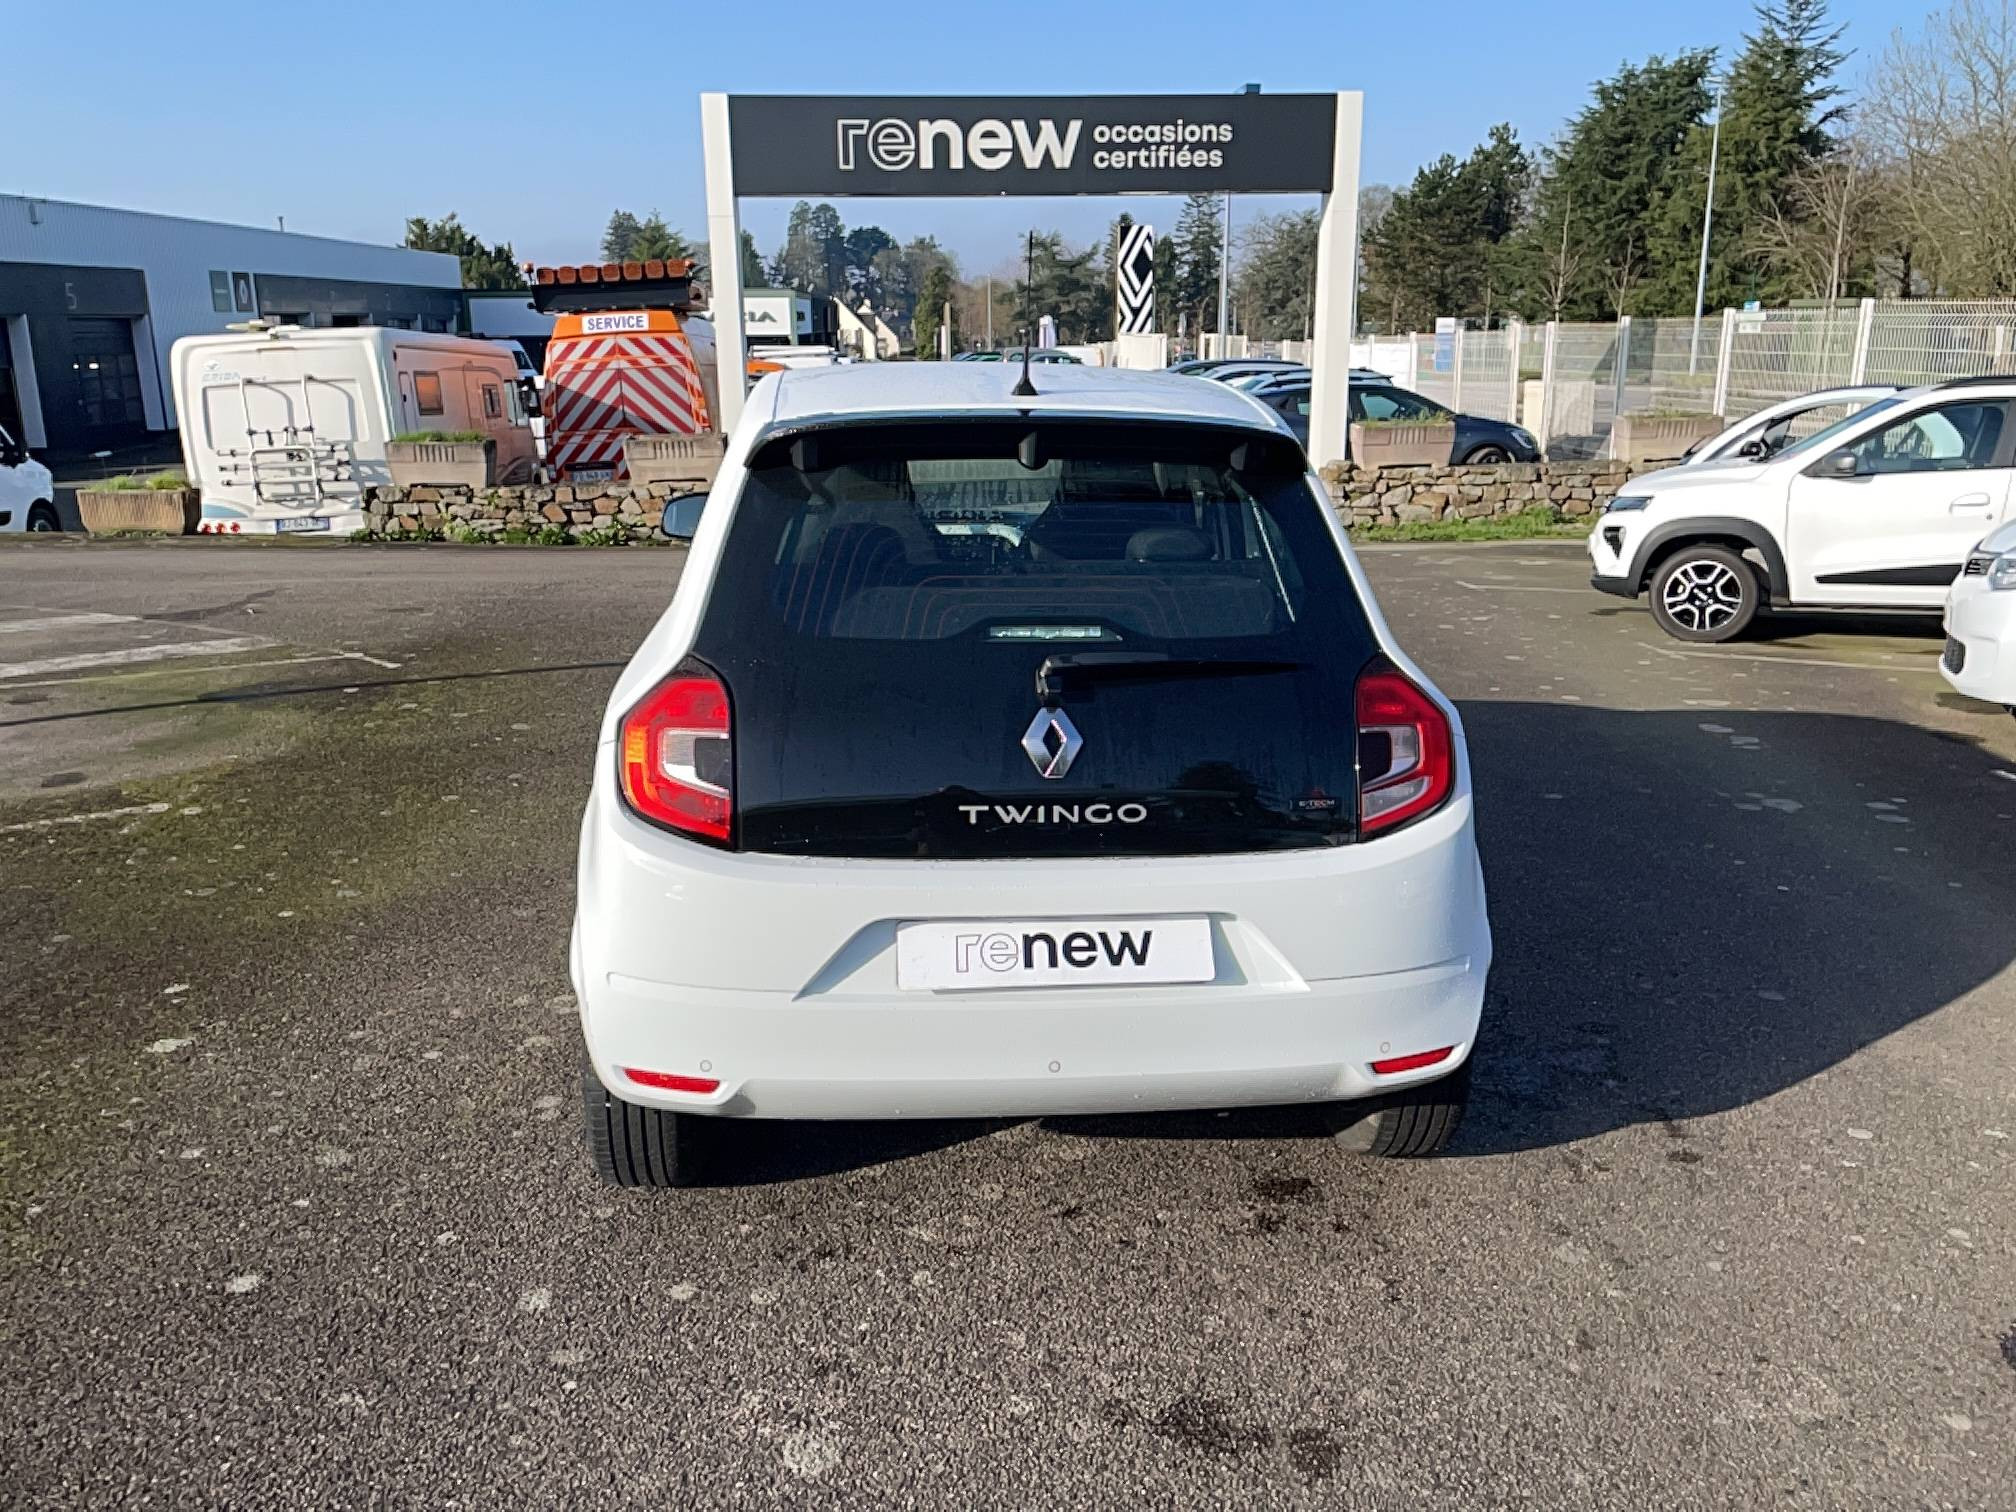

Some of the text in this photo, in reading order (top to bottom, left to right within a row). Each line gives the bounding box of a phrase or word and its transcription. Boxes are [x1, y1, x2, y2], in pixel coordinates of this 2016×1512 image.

[1092, 119, 1233, 144] occasions
[836, 118, 1083, 171] renew
[1092, 144, 1223, 169] certifiées
[64, 282, 78, 310] 5
[587, 315, 645, 331] SERVICE
[958, 803, 1147, 825] TWINGO
[955, 930, 1153, 974] renew
